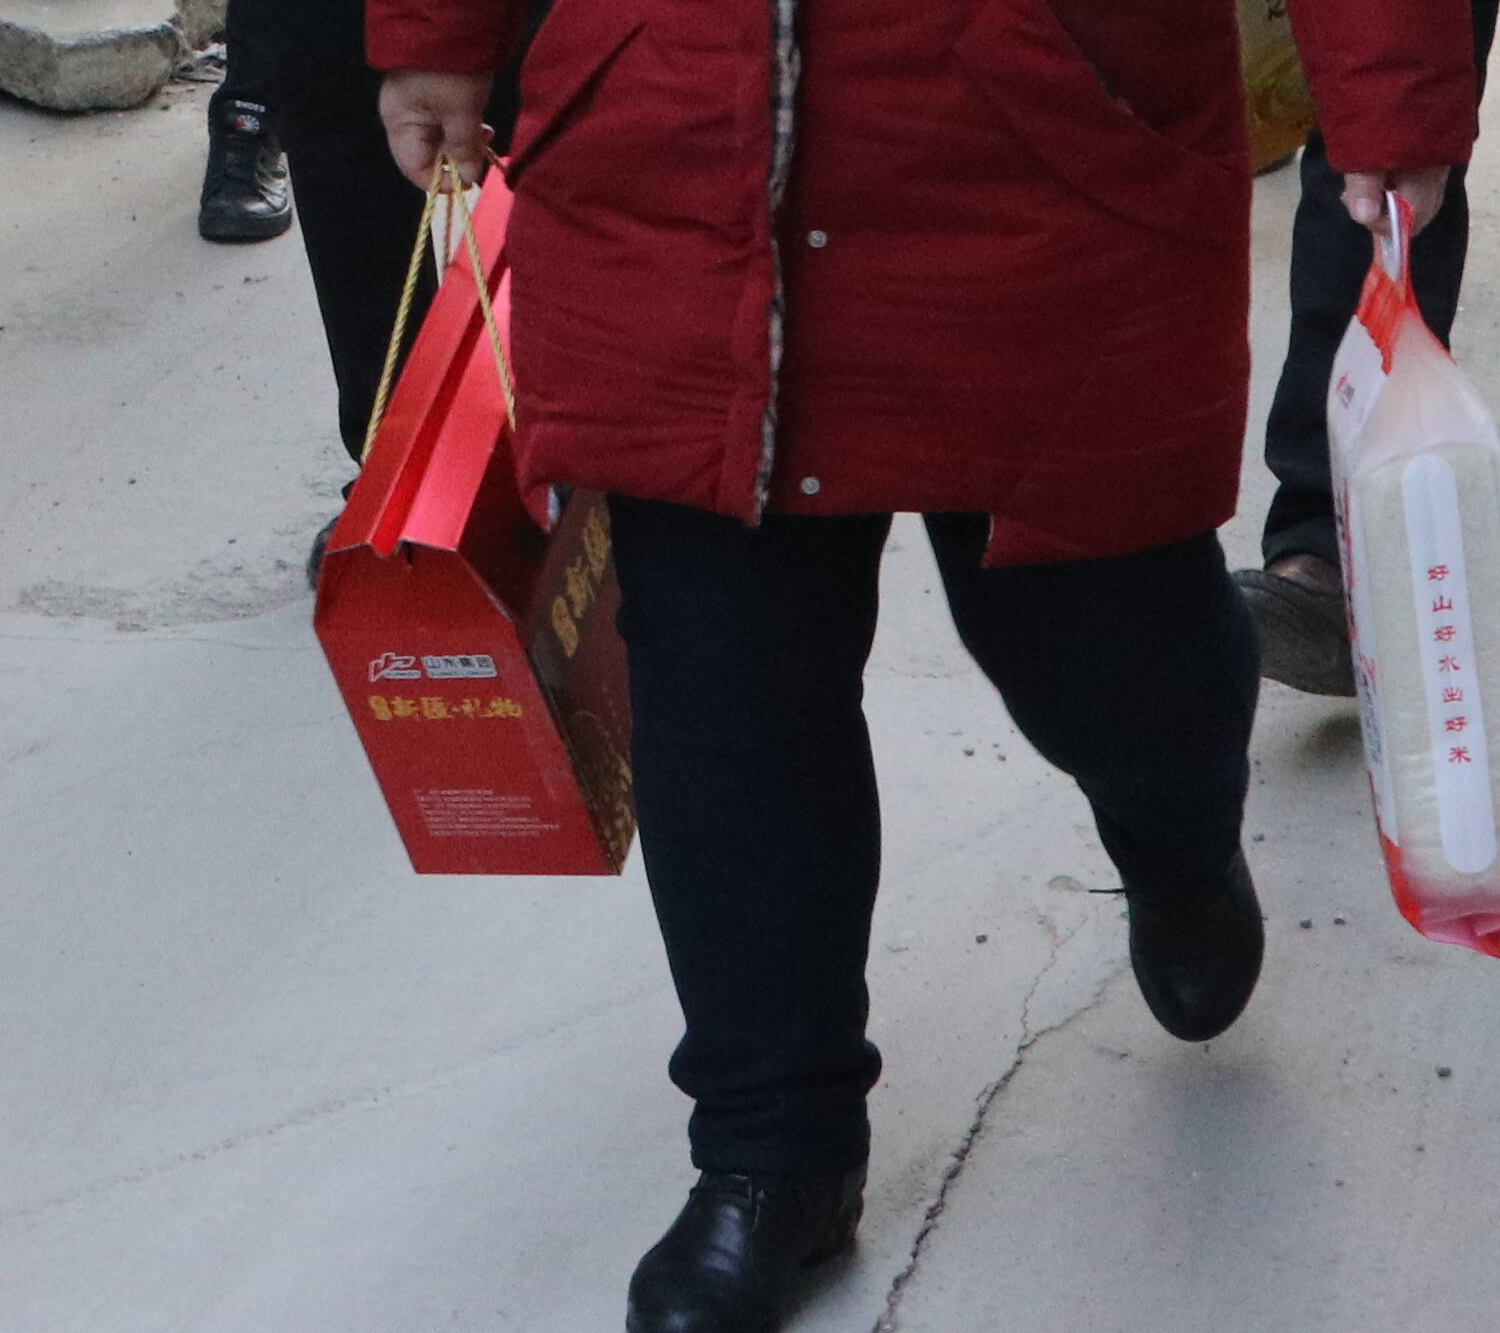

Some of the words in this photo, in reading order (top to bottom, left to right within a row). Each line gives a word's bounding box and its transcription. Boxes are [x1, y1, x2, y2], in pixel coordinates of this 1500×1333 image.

[1426, 564, 1473, 765] 好山好水出好米
